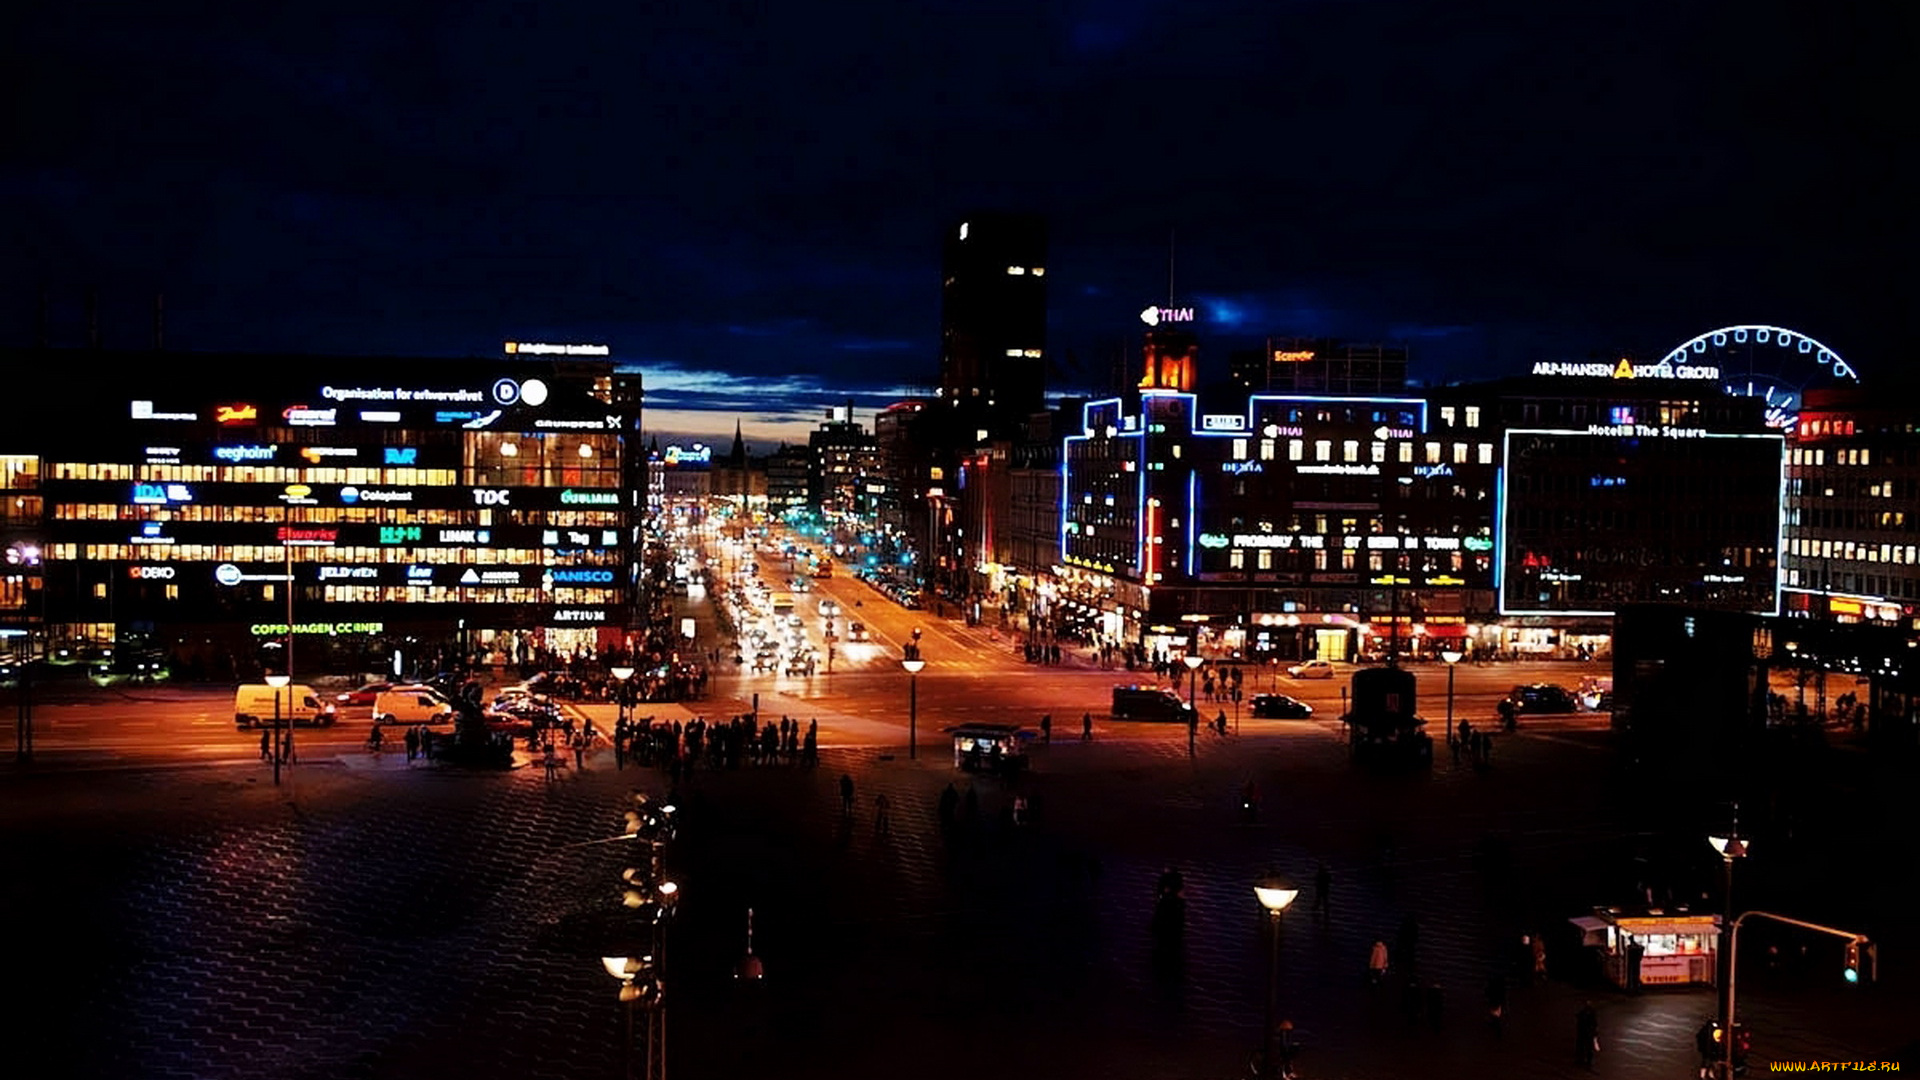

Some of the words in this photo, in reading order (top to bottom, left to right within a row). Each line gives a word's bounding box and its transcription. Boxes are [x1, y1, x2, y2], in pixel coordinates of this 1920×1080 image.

[1160, 308, 1194, 322] THAI
[1532, 362, 1614, 377] ARP-HANSEN
[1633, 364, 1675, 379] HOTEL
[322, 386, 394, 401] Organisation
[396, 388, 412, 400] for
[1588, 425, 1622, 437] Hotel
[1635, 426, 1659, 437] The
[1662, 427, 1707, 439] Square
[360, 490, 412, 501] Coloplast
[473, 489, 510, 505] TDC
[439, 530, 475, 542] LINAK
[1233, 535, 1293, 548] PROBABLY
[1299, 535, 1324, 548] THE
[1424, 536, 1460, 550] TOWN
[553, 609, 605, 621] ARTIUM
